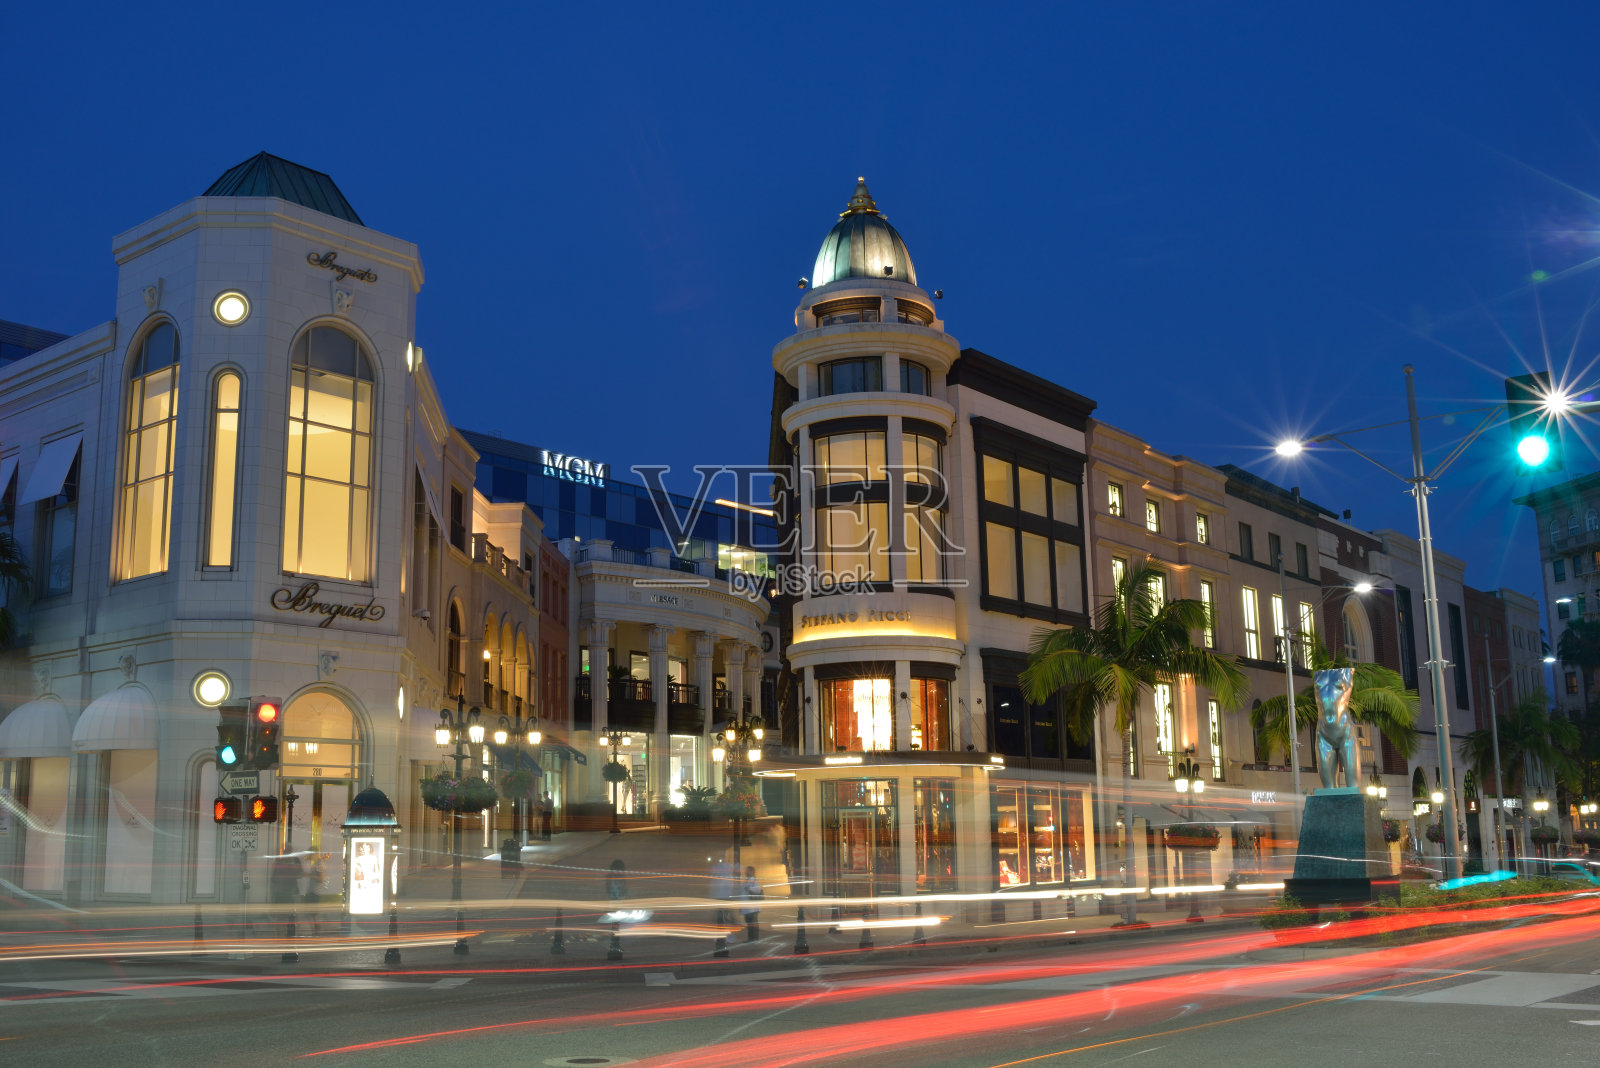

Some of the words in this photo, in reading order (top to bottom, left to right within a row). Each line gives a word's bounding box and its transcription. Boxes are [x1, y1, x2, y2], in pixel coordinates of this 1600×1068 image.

[541, 450, 609, 488] MGM
[270, 582, 386, 628] Breguet
[800, 611, 859, 629] STEFANO
[230, 777, 243, 788] ONE
[243, 776, 256, 787] WAY
[231, 839, 241, 849] OK
